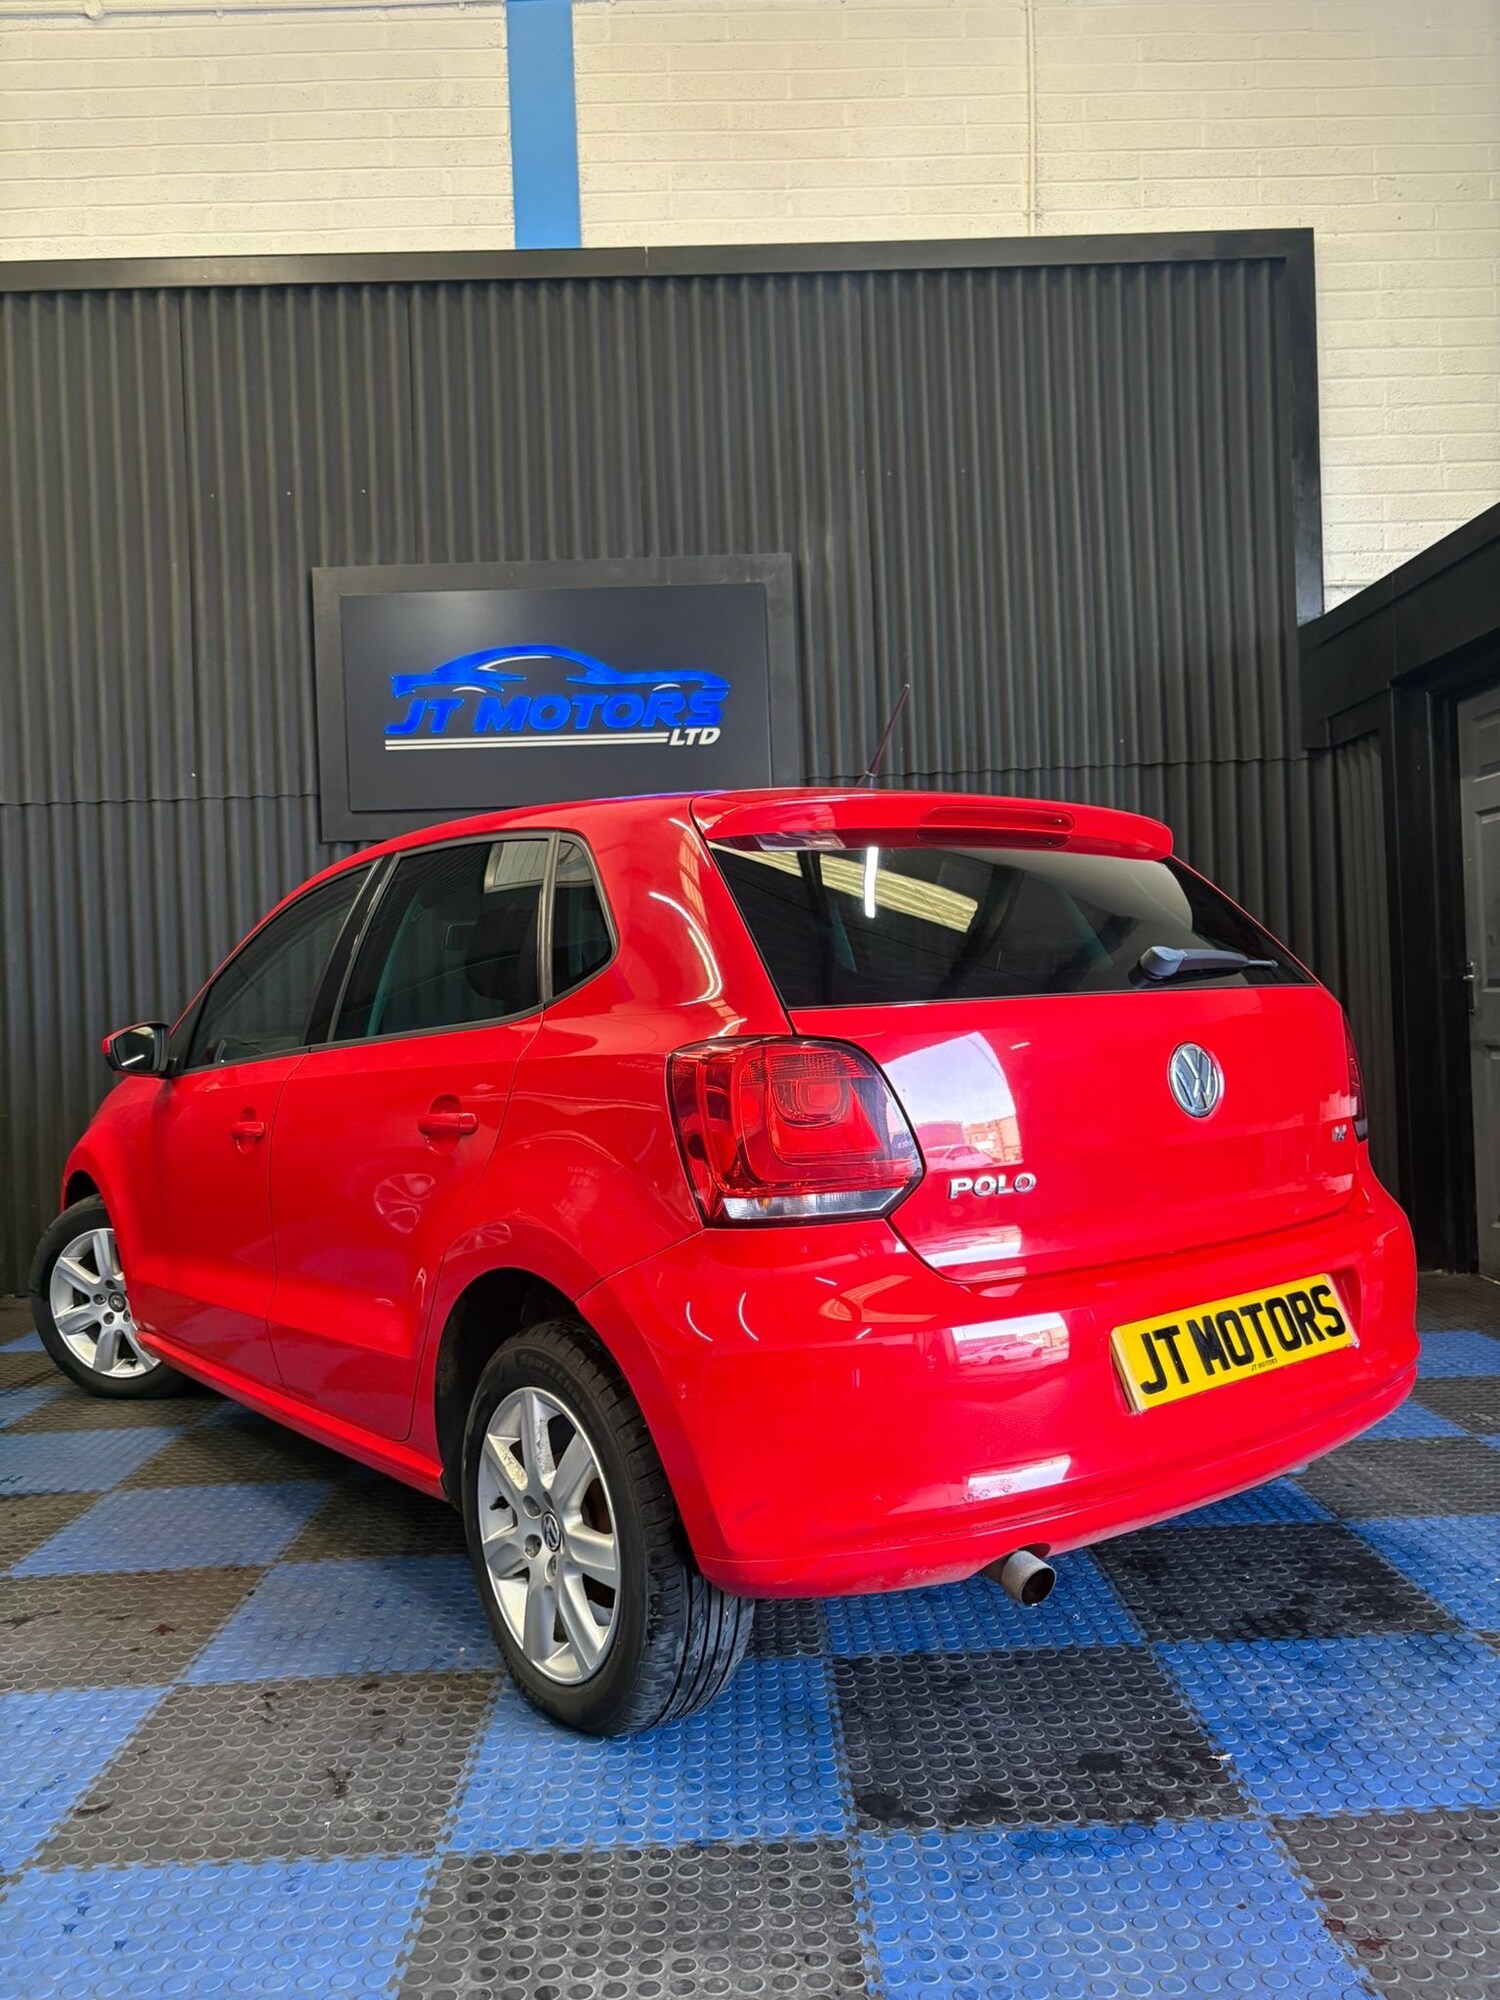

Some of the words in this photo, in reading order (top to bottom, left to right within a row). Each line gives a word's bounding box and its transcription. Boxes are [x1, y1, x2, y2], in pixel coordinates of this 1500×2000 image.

[384, 697, 464, 735] JT
[473, 691, 729, 732] MOTORS
[668, 727, 721, 747] LTD
[948, 1172, 1037, 1200] POLO
[1140, 1324, 1190, 1395] JT
[1186, 1284, 1347, 1376] MOTORS
